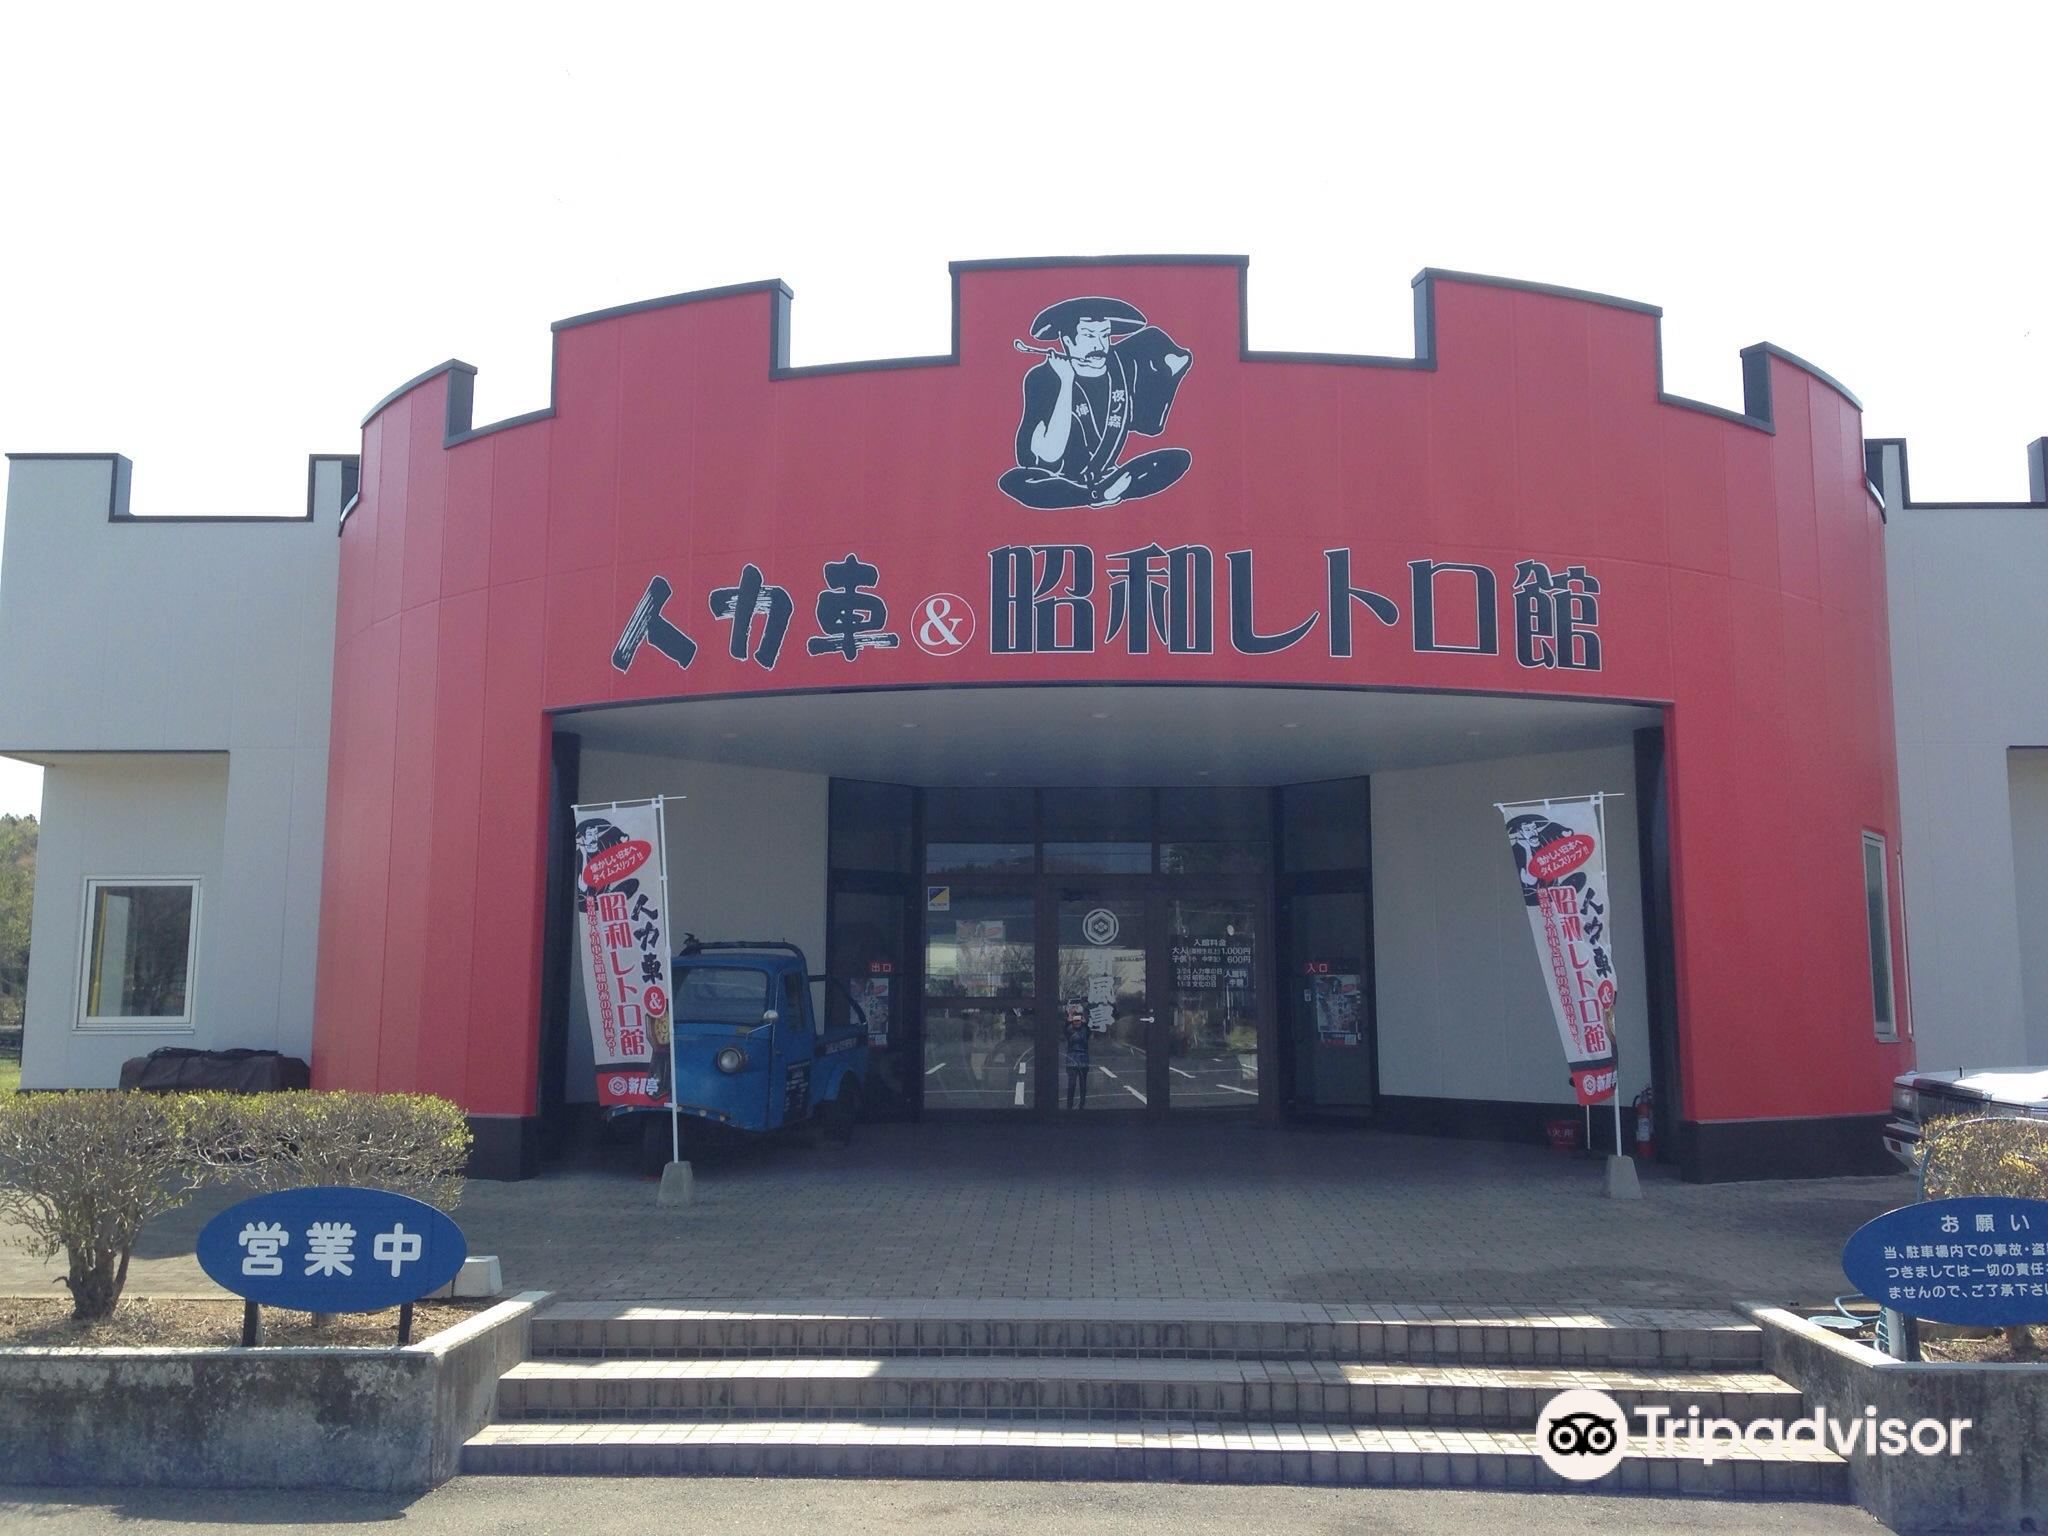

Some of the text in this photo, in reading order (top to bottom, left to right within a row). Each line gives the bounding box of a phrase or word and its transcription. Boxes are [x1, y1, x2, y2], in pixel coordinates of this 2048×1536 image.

[598, 892, 645, 1056] 昭和レトロ館
[871, 962, 892, 973] 出口
[1307, 963, 1329, 973] 入口
[1549, 887, 1606, 1053] 昭和レトロ館
[1941, 1213, 2030, 1233] お願い
[239, 1221, 422, 1278] 営業中
[1884, 1242, 2048, 1260] 当、駐車場内での事故・盗
[1885, 1262, 2048, 1279] つきましては一切の責任
